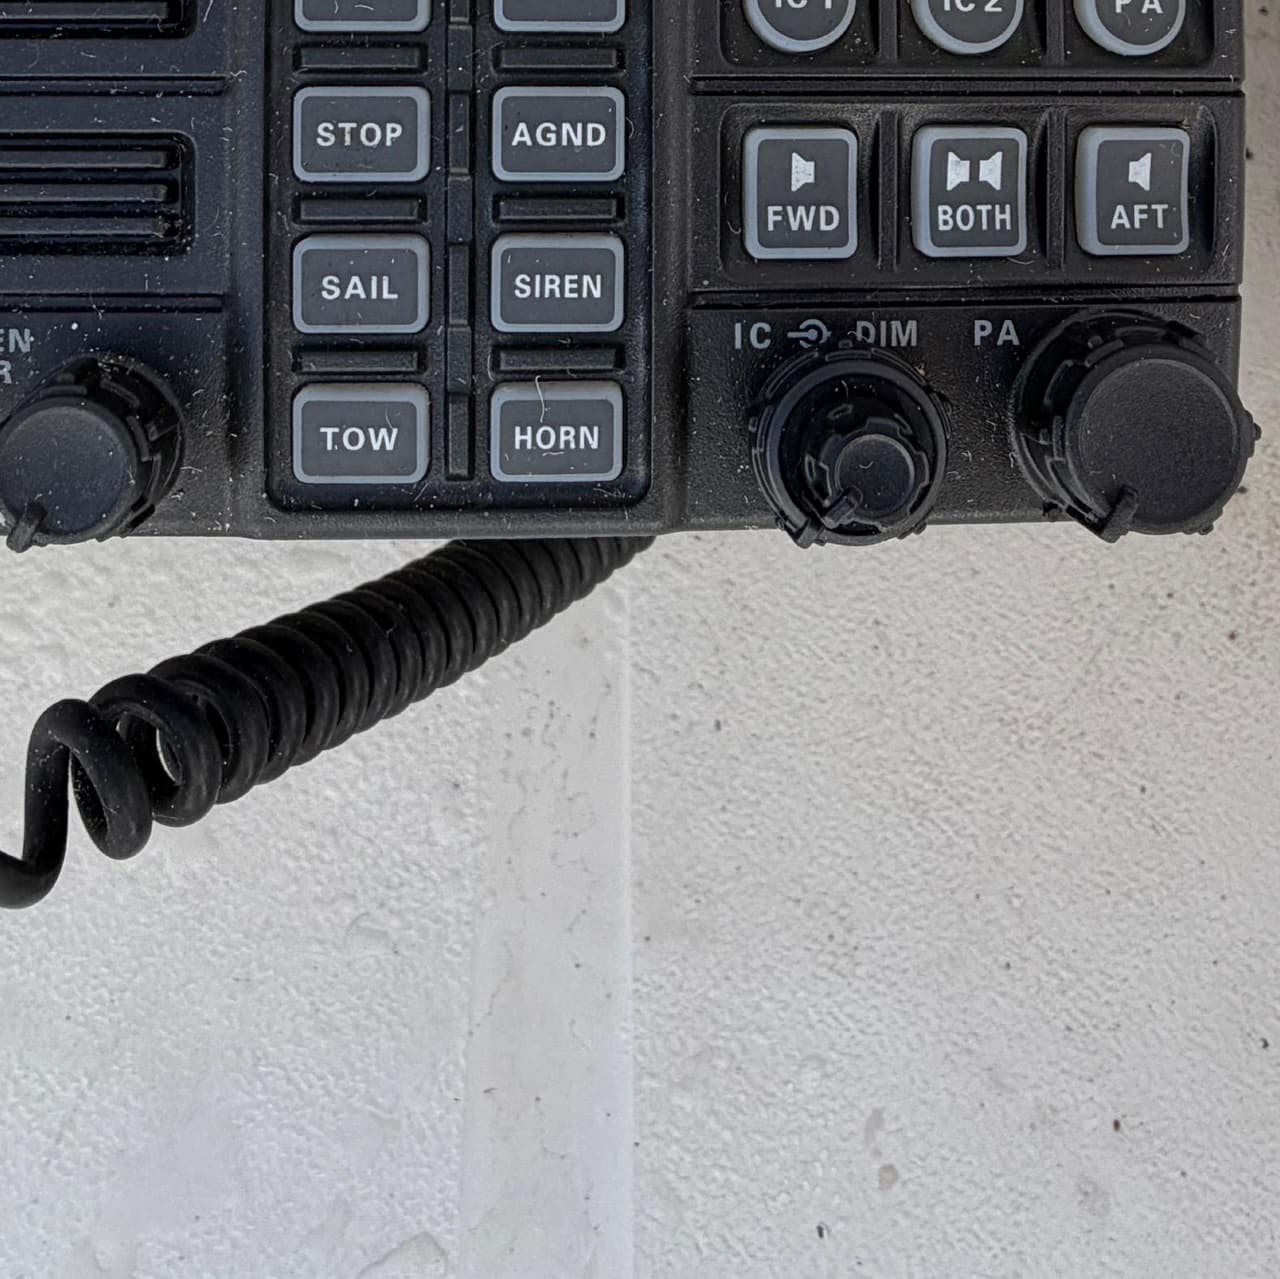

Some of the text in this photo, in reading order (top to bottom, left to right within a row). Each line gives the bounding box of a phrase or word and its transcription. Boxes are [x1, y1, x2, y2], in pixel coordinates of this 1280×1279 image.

[315, 121, 403, 147] STOP
[511, 121, 608, 147] AGND
[766, 204, 840, 232] FWD
[936, 204, 1013, 232] BOTH
[1109, 203, 1169, 230] AFT
[320, 275, 399, 301] SAIL
[513, 273, 603, 299] SIREN
[734, 320, 919, 350] IC DIM
[972, 319, 1021, 347] PA
[320, 426, 399, 451] TOW
[513, 424, 600, 450] HORN
